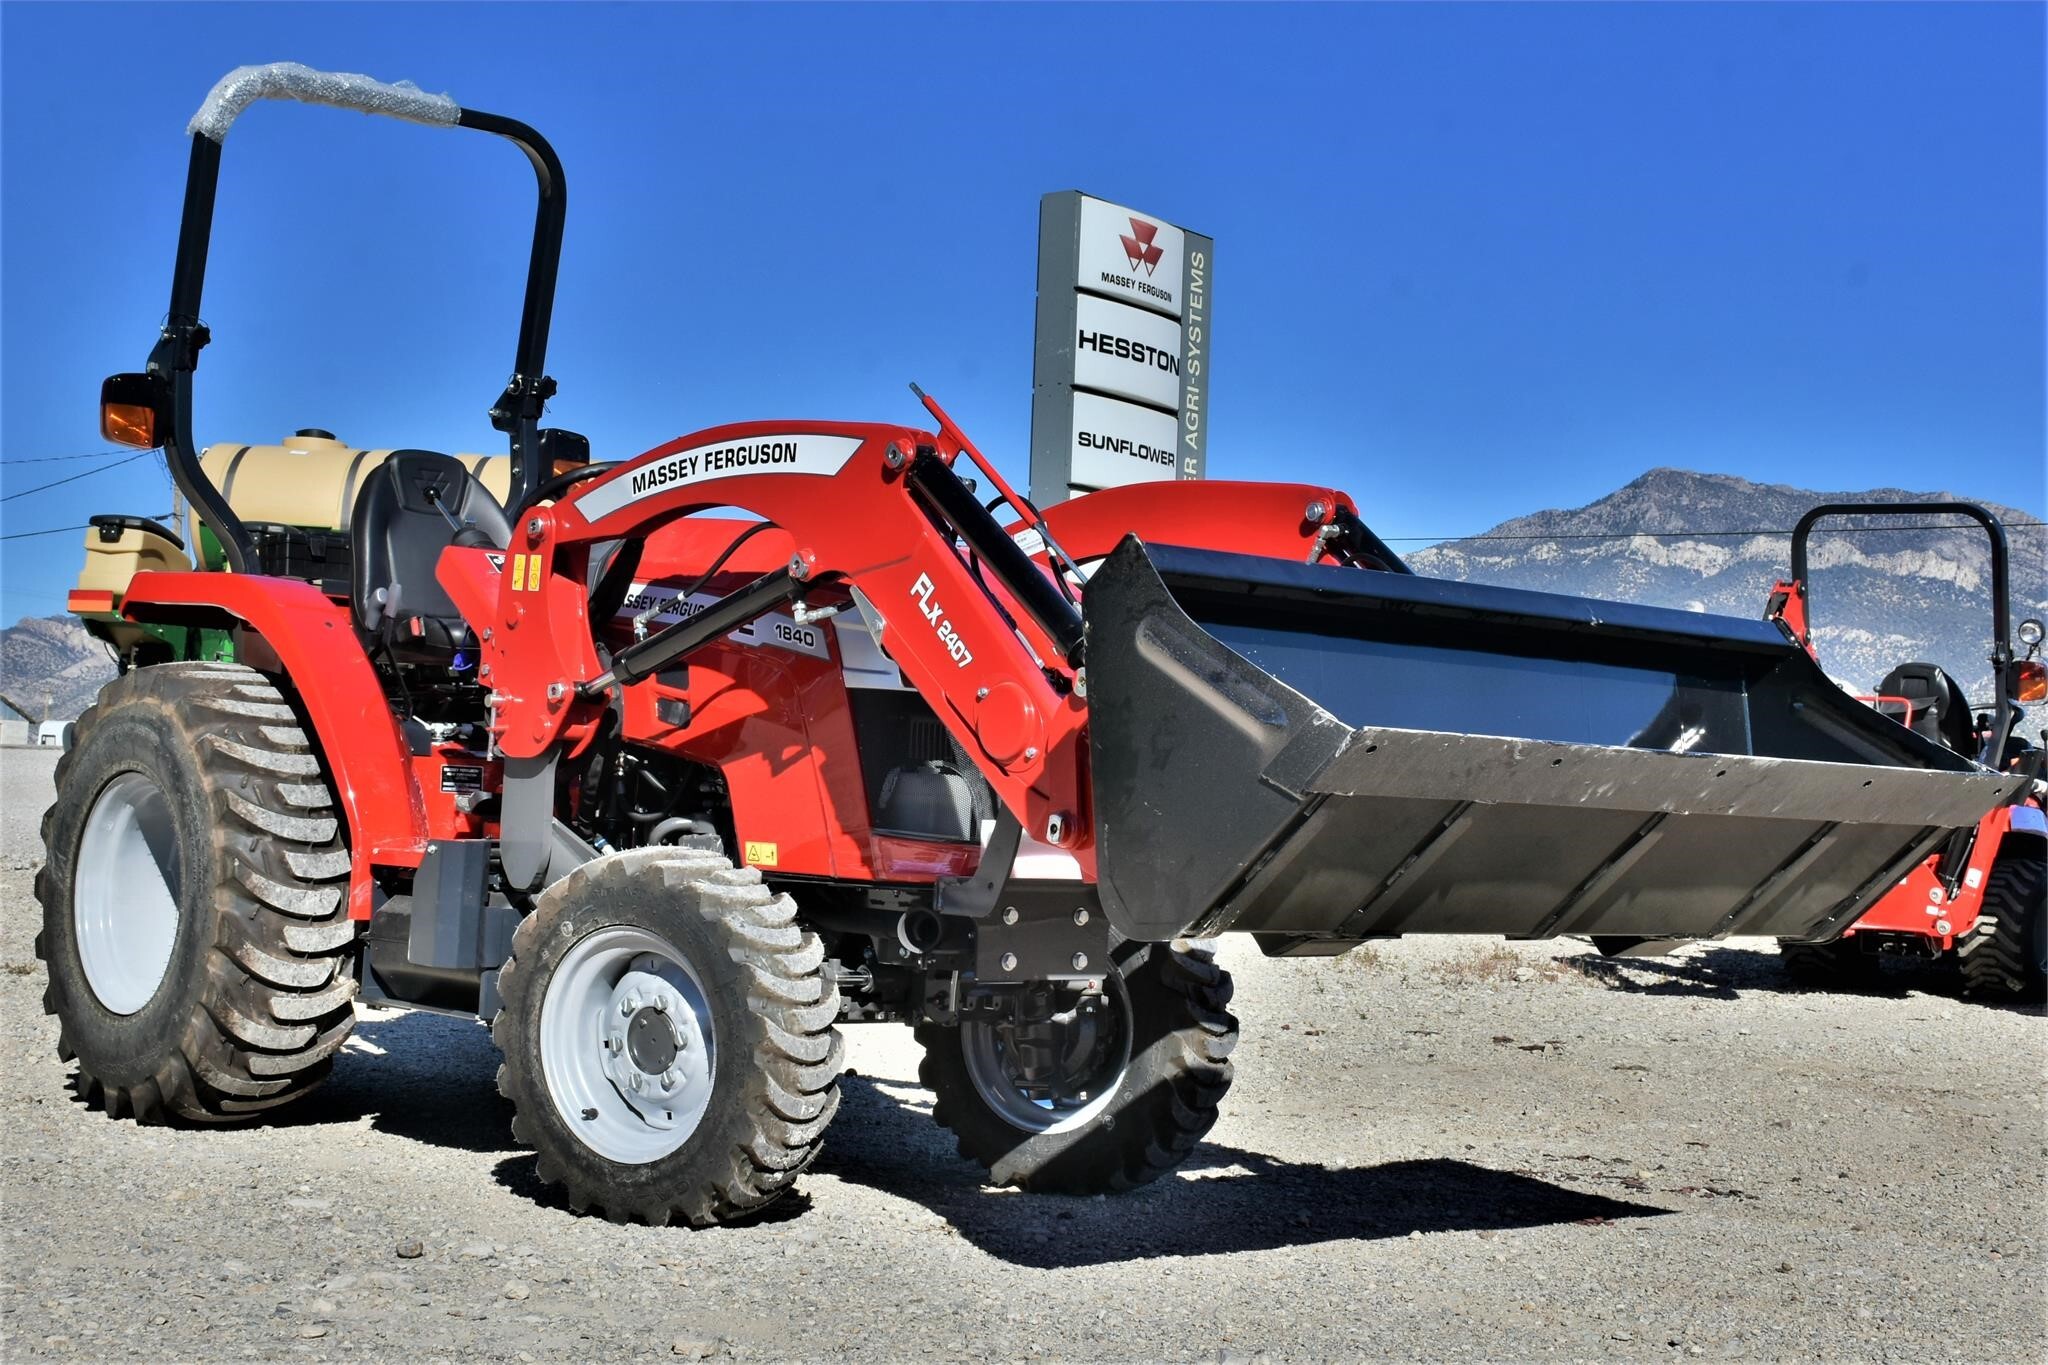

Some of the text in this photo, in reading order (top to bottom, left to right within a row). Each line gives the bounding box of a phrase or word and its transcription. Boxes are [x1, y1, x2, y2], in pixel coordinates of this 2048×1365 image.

[1101, 272, 1172, 303] MASSEY FERGUSON
[1078, 329, 1180, 377] HESSTON
[1184, 251, 1205, 450] AGRI-SYSTEMS
[632, 442, 797, 495] MASSEY FERGUSON
[1078, 431, 1175, 467] SUNFLOWER
[622, 594, 657, 610] SSEY
[775, 624, 814, 647] 1840
[936, 619, 973, 668] 2407
